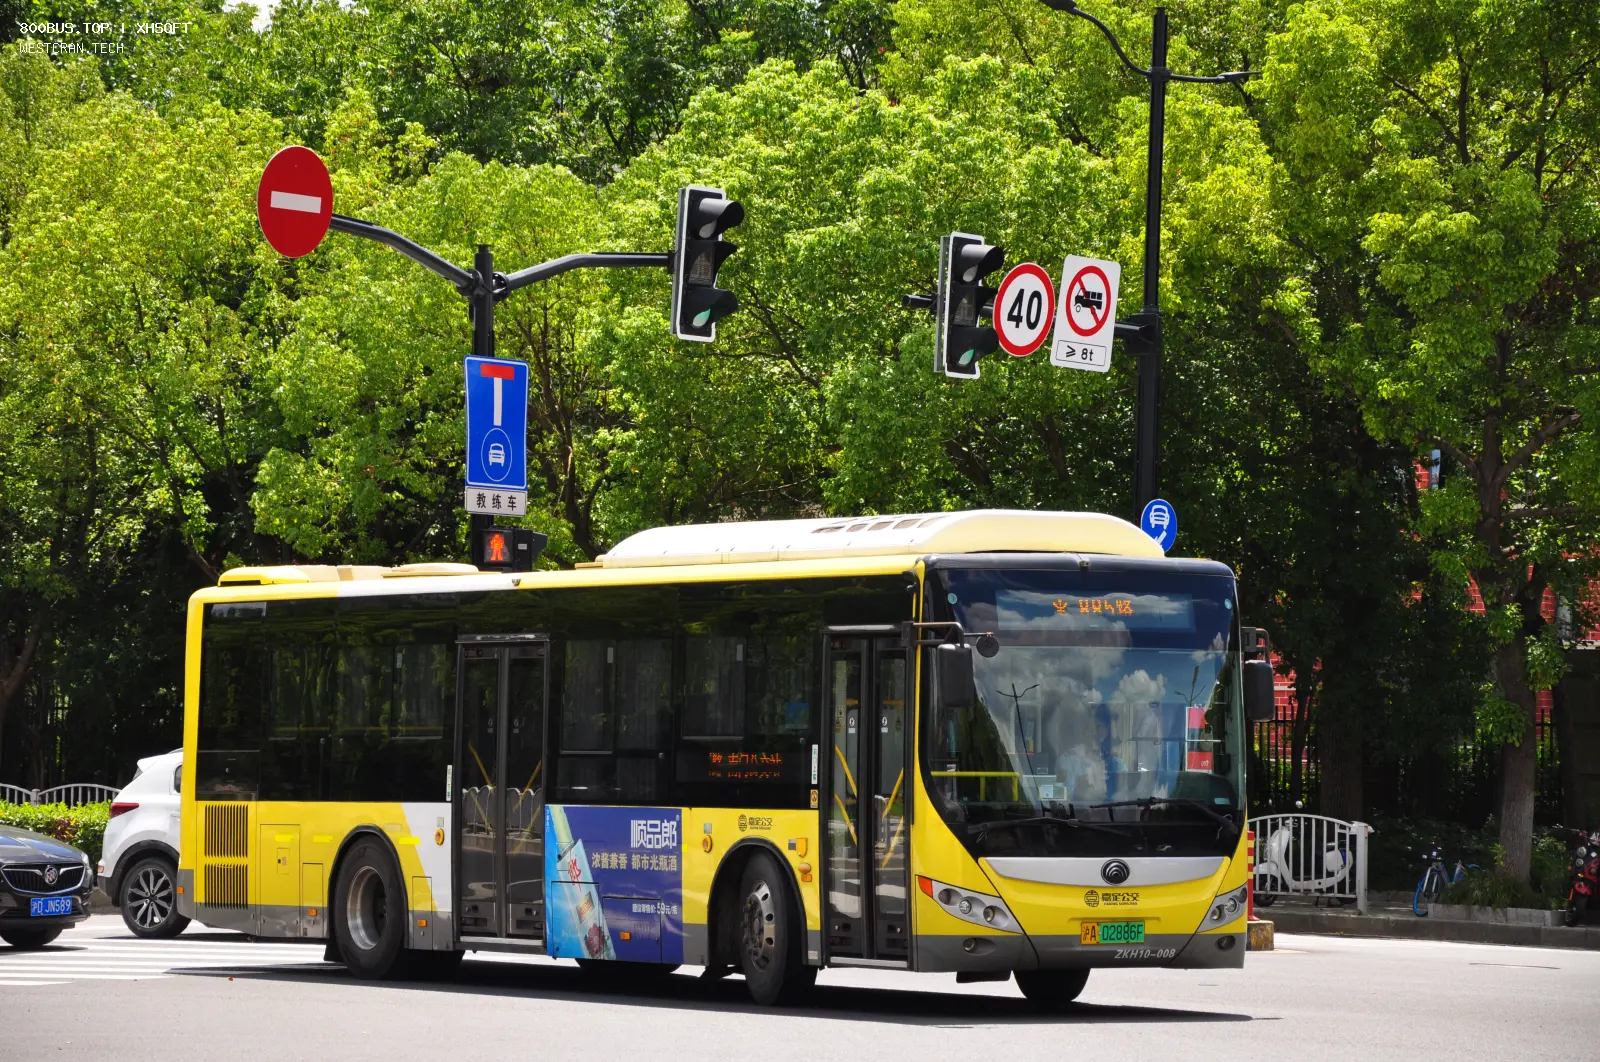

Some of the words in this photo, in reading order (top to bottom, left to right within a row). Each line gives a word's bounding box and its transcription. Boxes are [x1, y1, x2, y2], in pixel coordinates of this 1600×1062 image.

[1007, 288, 1043, 330] 40
[476, 492, 517, 511] 教练车
[630, 819, 677, 849] 顺品郎
[591, 852, 628, 870] 浓酱兼香
[631, 854, 677, 872] 都市光瓶酒
[1101, 892, 1140, 902] 嘉定公交
[1114, 948, 1176, 959] ZKH10-008
